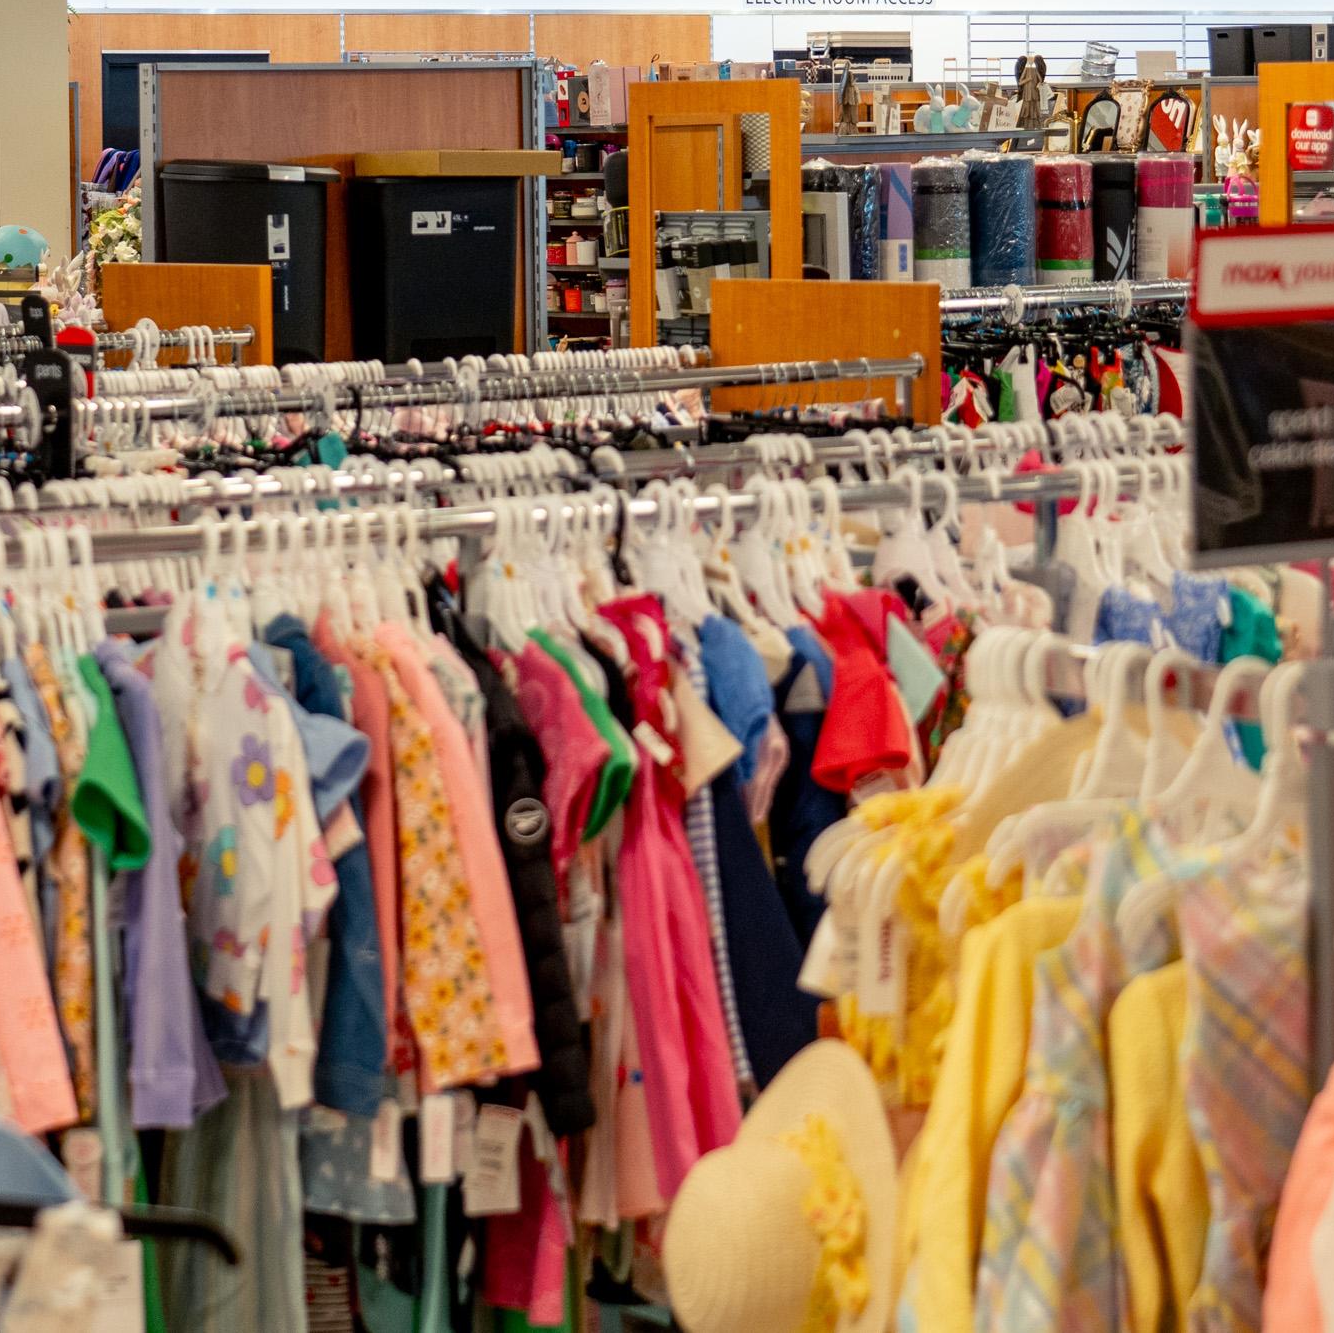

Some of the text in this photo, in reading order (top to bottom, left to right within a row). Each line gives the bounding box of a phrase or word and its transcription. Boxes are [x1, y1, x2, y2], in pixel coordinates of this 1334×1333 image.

[1290, 129, 1332, 140] download
[1294, 141, 1328, 153] our app
